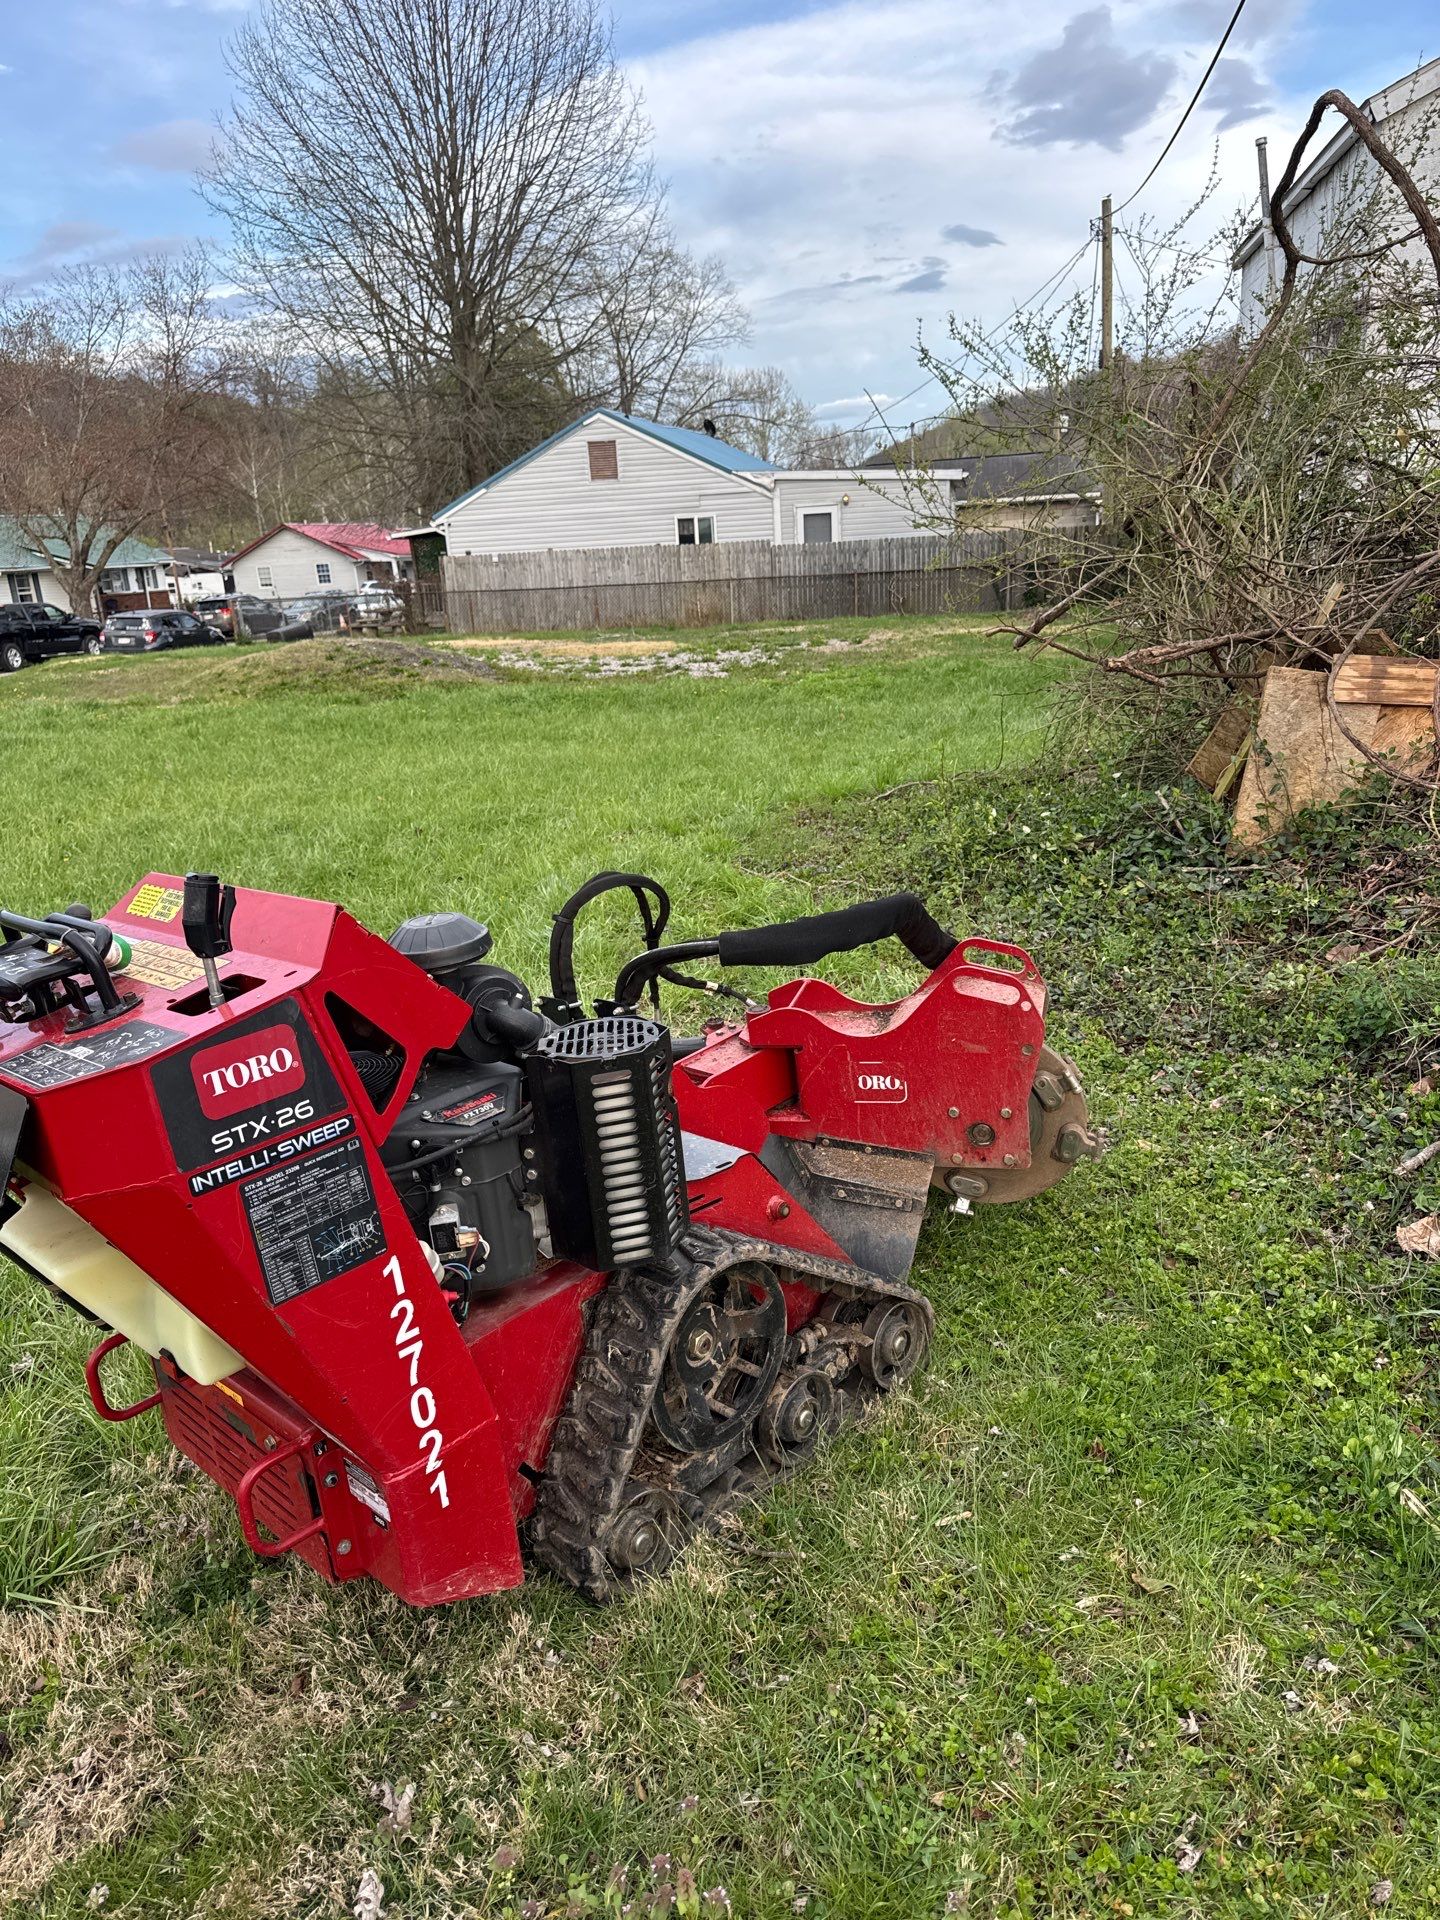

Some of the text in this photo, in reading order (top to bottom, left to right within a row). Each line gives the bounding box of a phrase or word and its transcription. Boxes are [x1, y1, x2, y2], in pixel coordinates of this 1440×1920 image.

[203, 1047, 295, 1097] TORO
[192, 1117, 350, 1193] INTELLI-SWEEP
[383, 1255, 450, 1509] 127021
